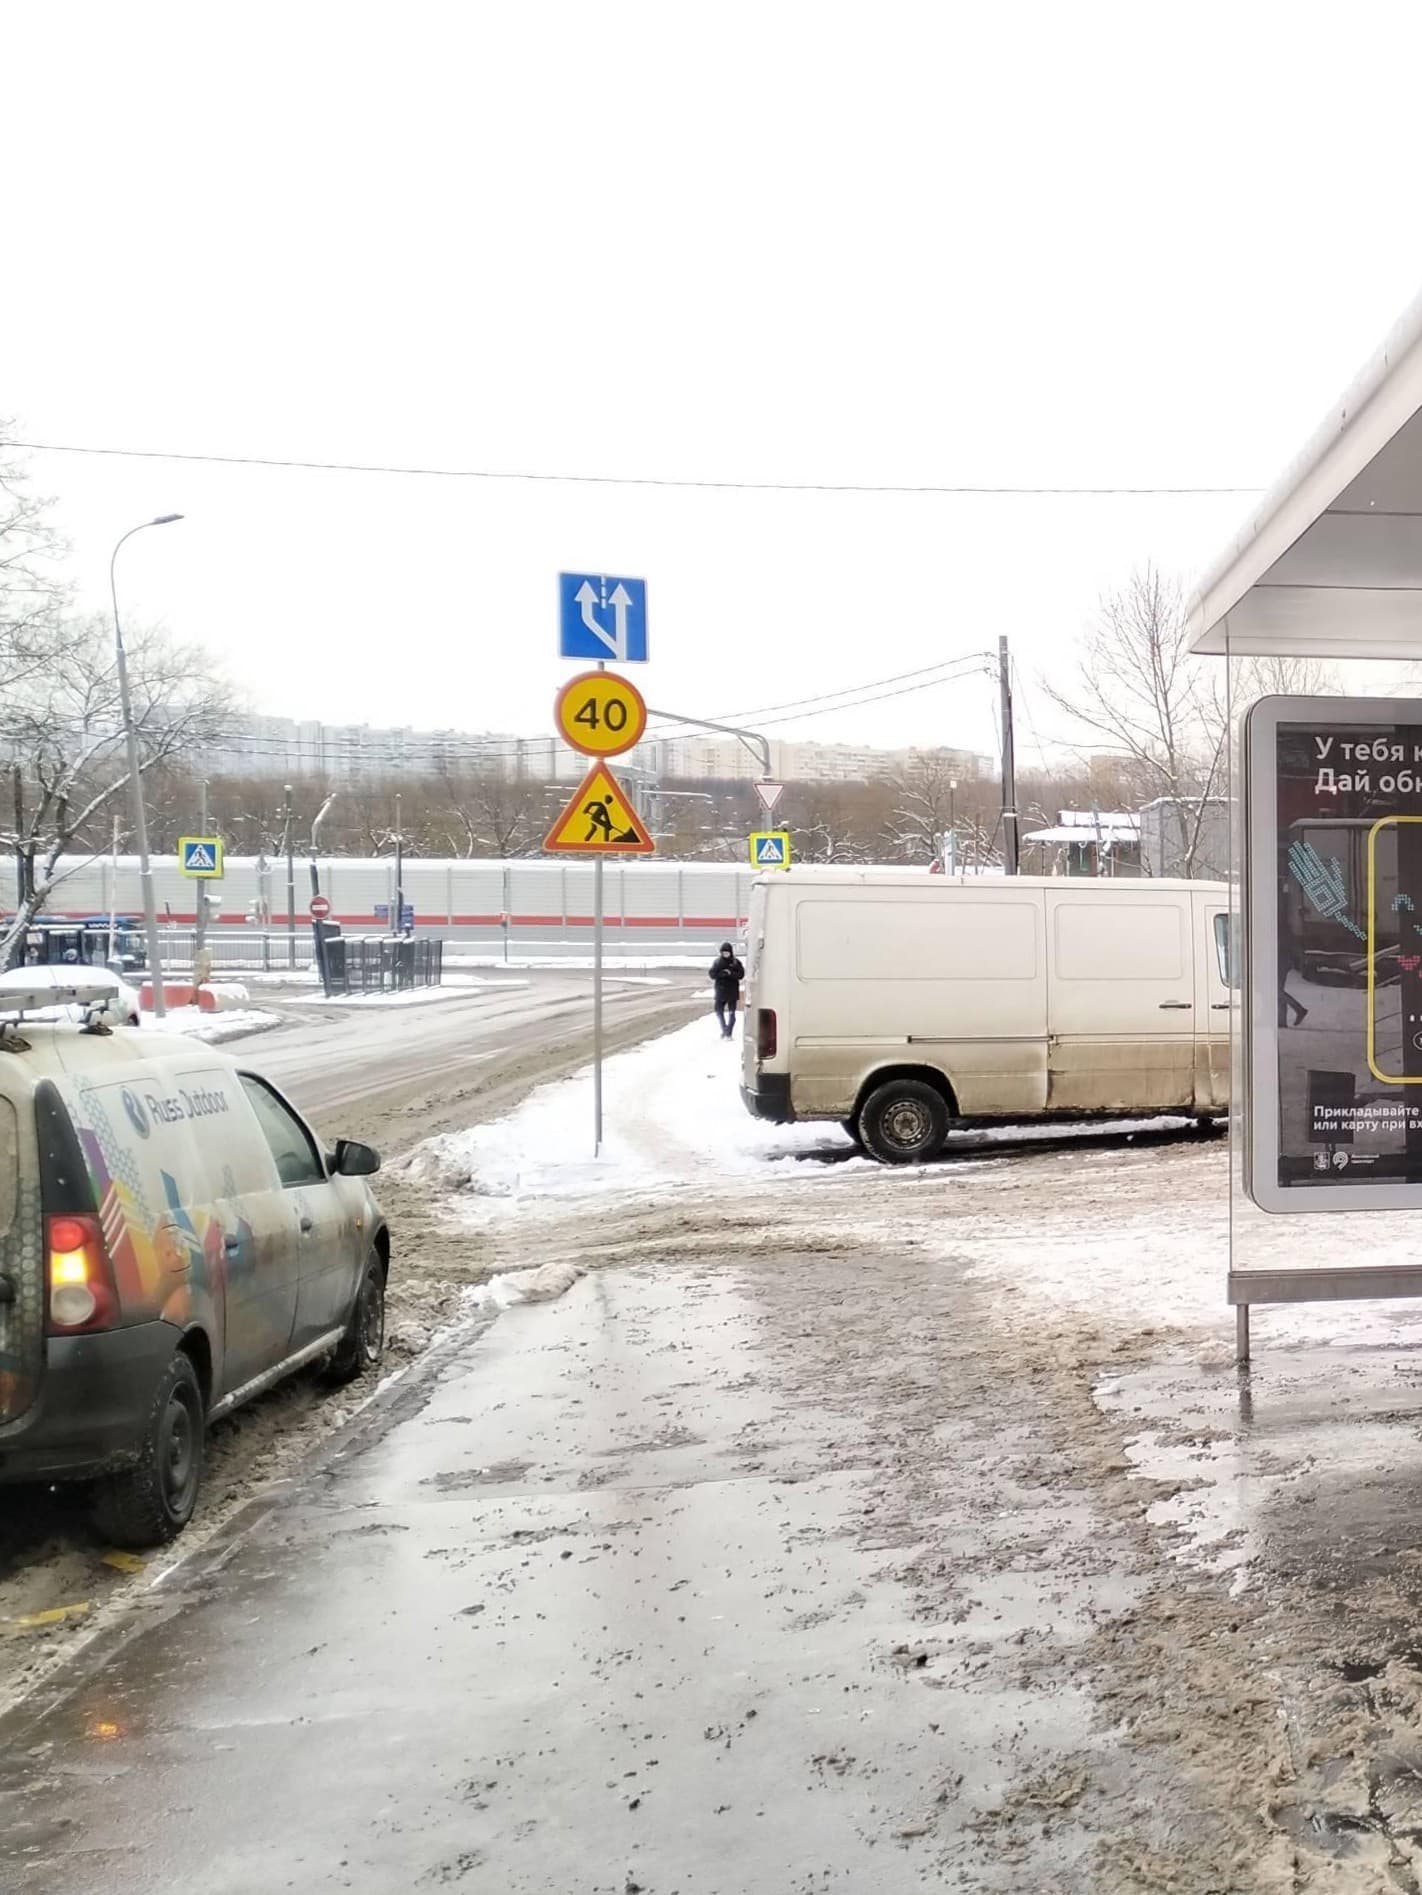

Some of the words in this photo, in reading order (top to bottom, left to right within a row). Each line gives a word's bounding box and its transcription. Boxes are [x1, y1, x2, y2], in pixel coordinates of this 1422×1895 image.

[573, 697, 627, 732] 40
[1315, 736, 1334, 760] У
[1340, 737, 1404, 762] тебя
[1314, 768, 1370, 796] Дай
[143, 1093, 185, 1126] Russ
[1313, 1104, 1420, 1120] Прикладывайте
[1313, 1120, 1338, 1131] или
[1341, 1120, 1379, 1132] карту
[1381, 1120, 1406, 1132] при
